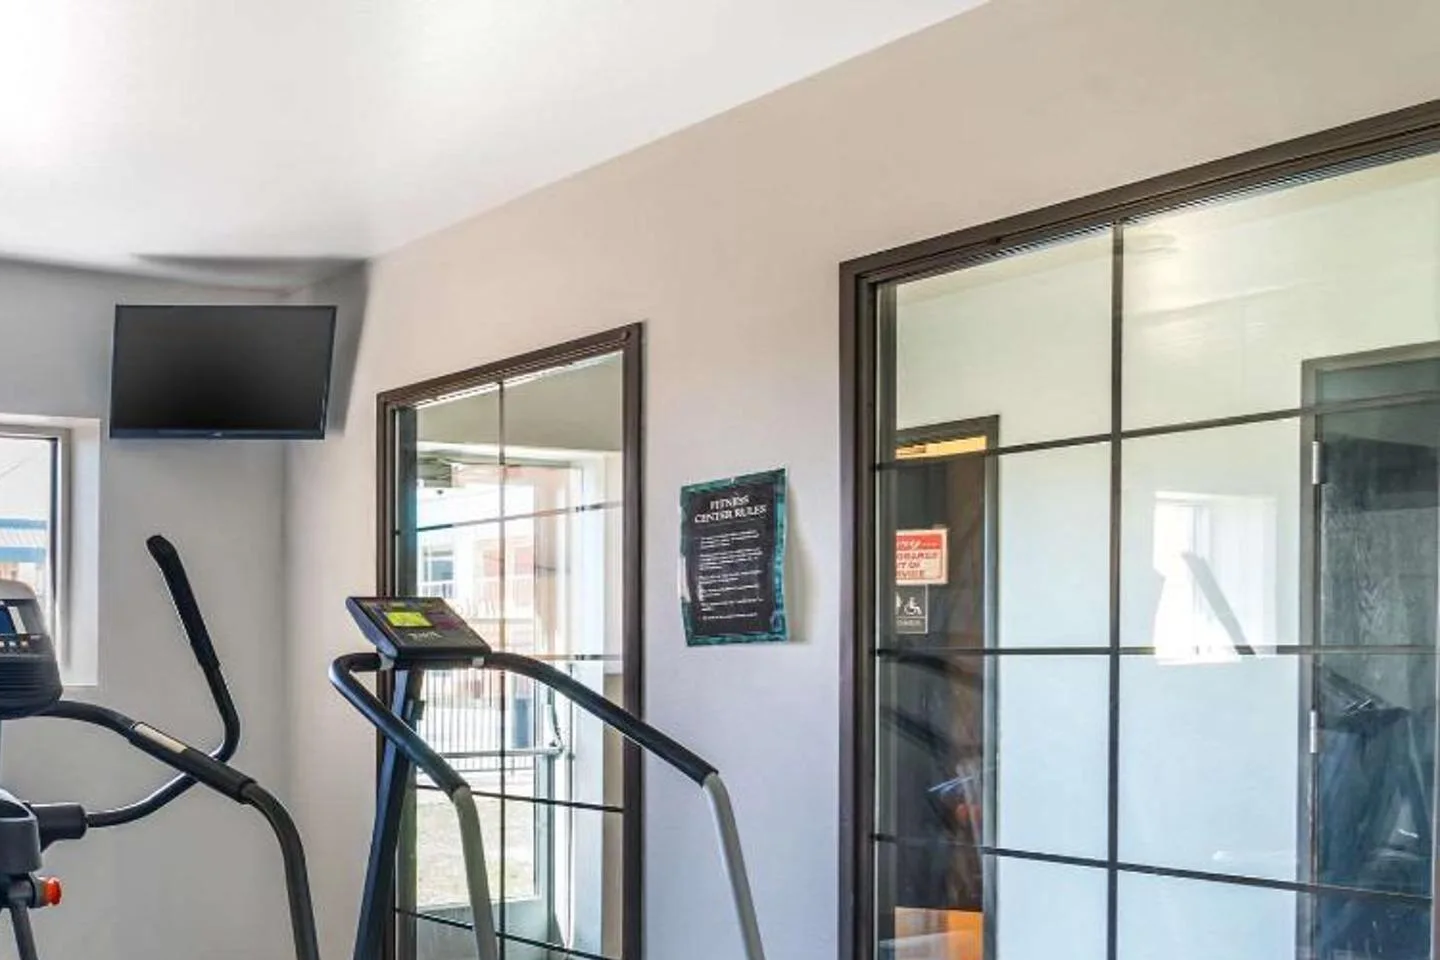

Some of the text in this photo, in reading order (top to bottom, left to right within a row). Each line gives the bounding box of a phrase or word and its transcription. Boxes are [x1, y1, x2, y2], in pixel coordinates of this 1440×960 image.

[710, 495, 749, 510] FITNESS
[694, 504, 767, 523] CENTER RULES
